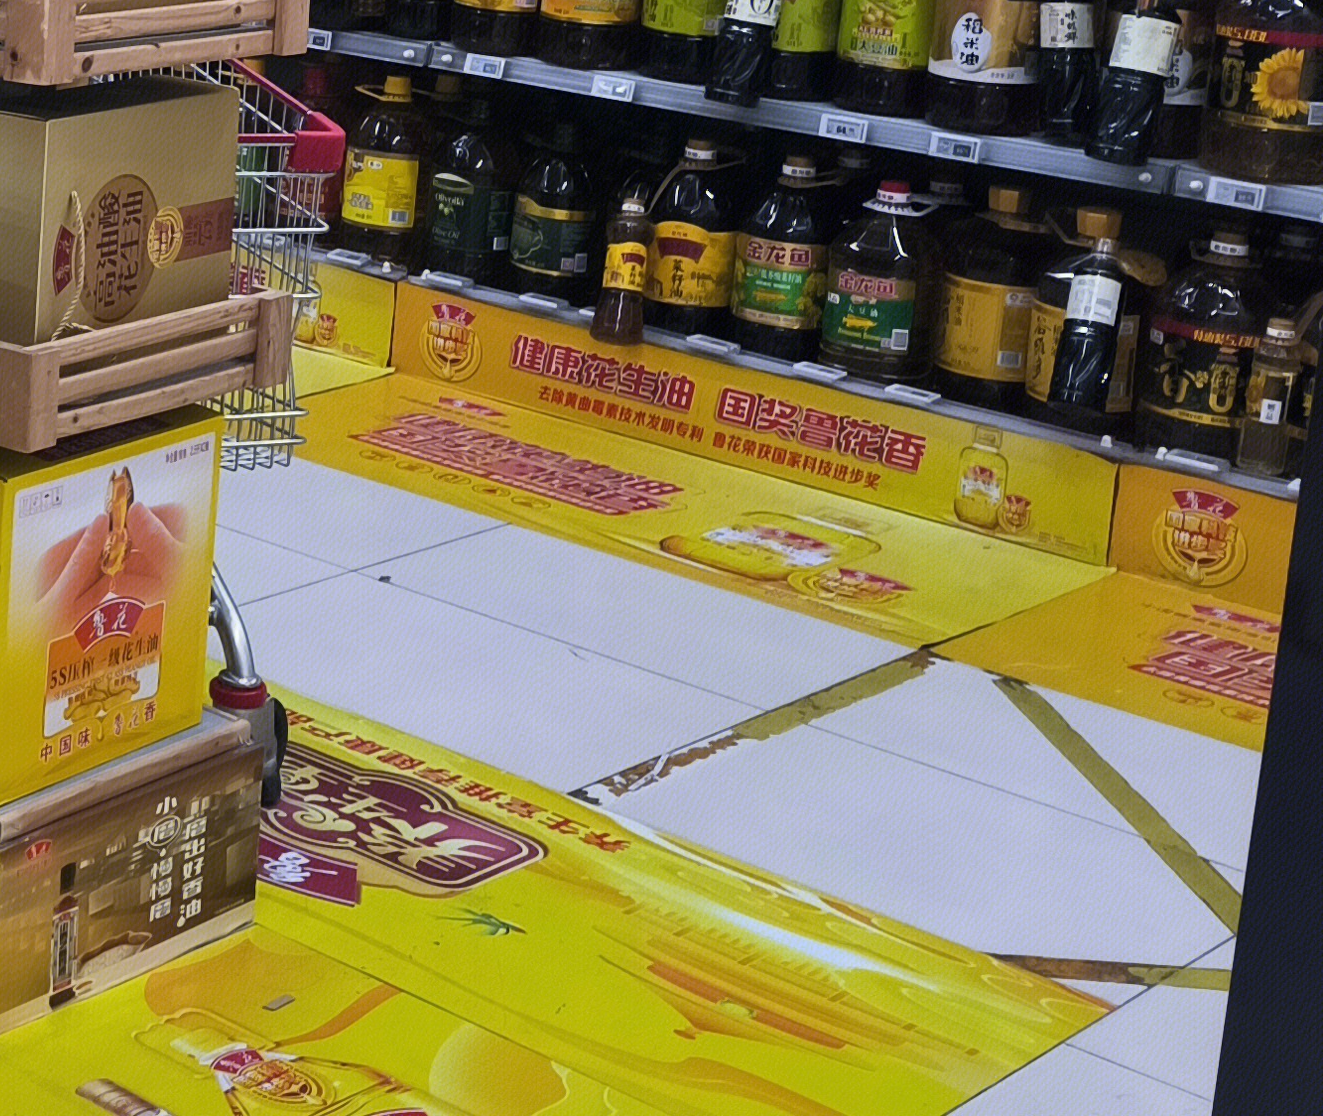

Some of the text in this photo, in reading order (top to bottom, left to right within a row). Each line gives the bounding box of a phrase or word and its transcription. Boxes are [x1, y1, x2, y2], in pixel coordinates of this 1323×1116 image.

[93, 184, 122, 307] 高油酸
[116, 185, 145, 298] 花生油
[747, 239, 812, 269] 金龙鱼
[837, 270, 899, 298] 金龙鱼
[507, 334, 696, 412] 健康花生油
[538, 385, 704, 442] 去除黄曲霉素技术发明专利
[712, 429, 881, 493] 鲁花荣获国家科技进步奖
[714, 384, 927, 476] 国奖鲁花香
[39, 726, 92, 764] 中国味
